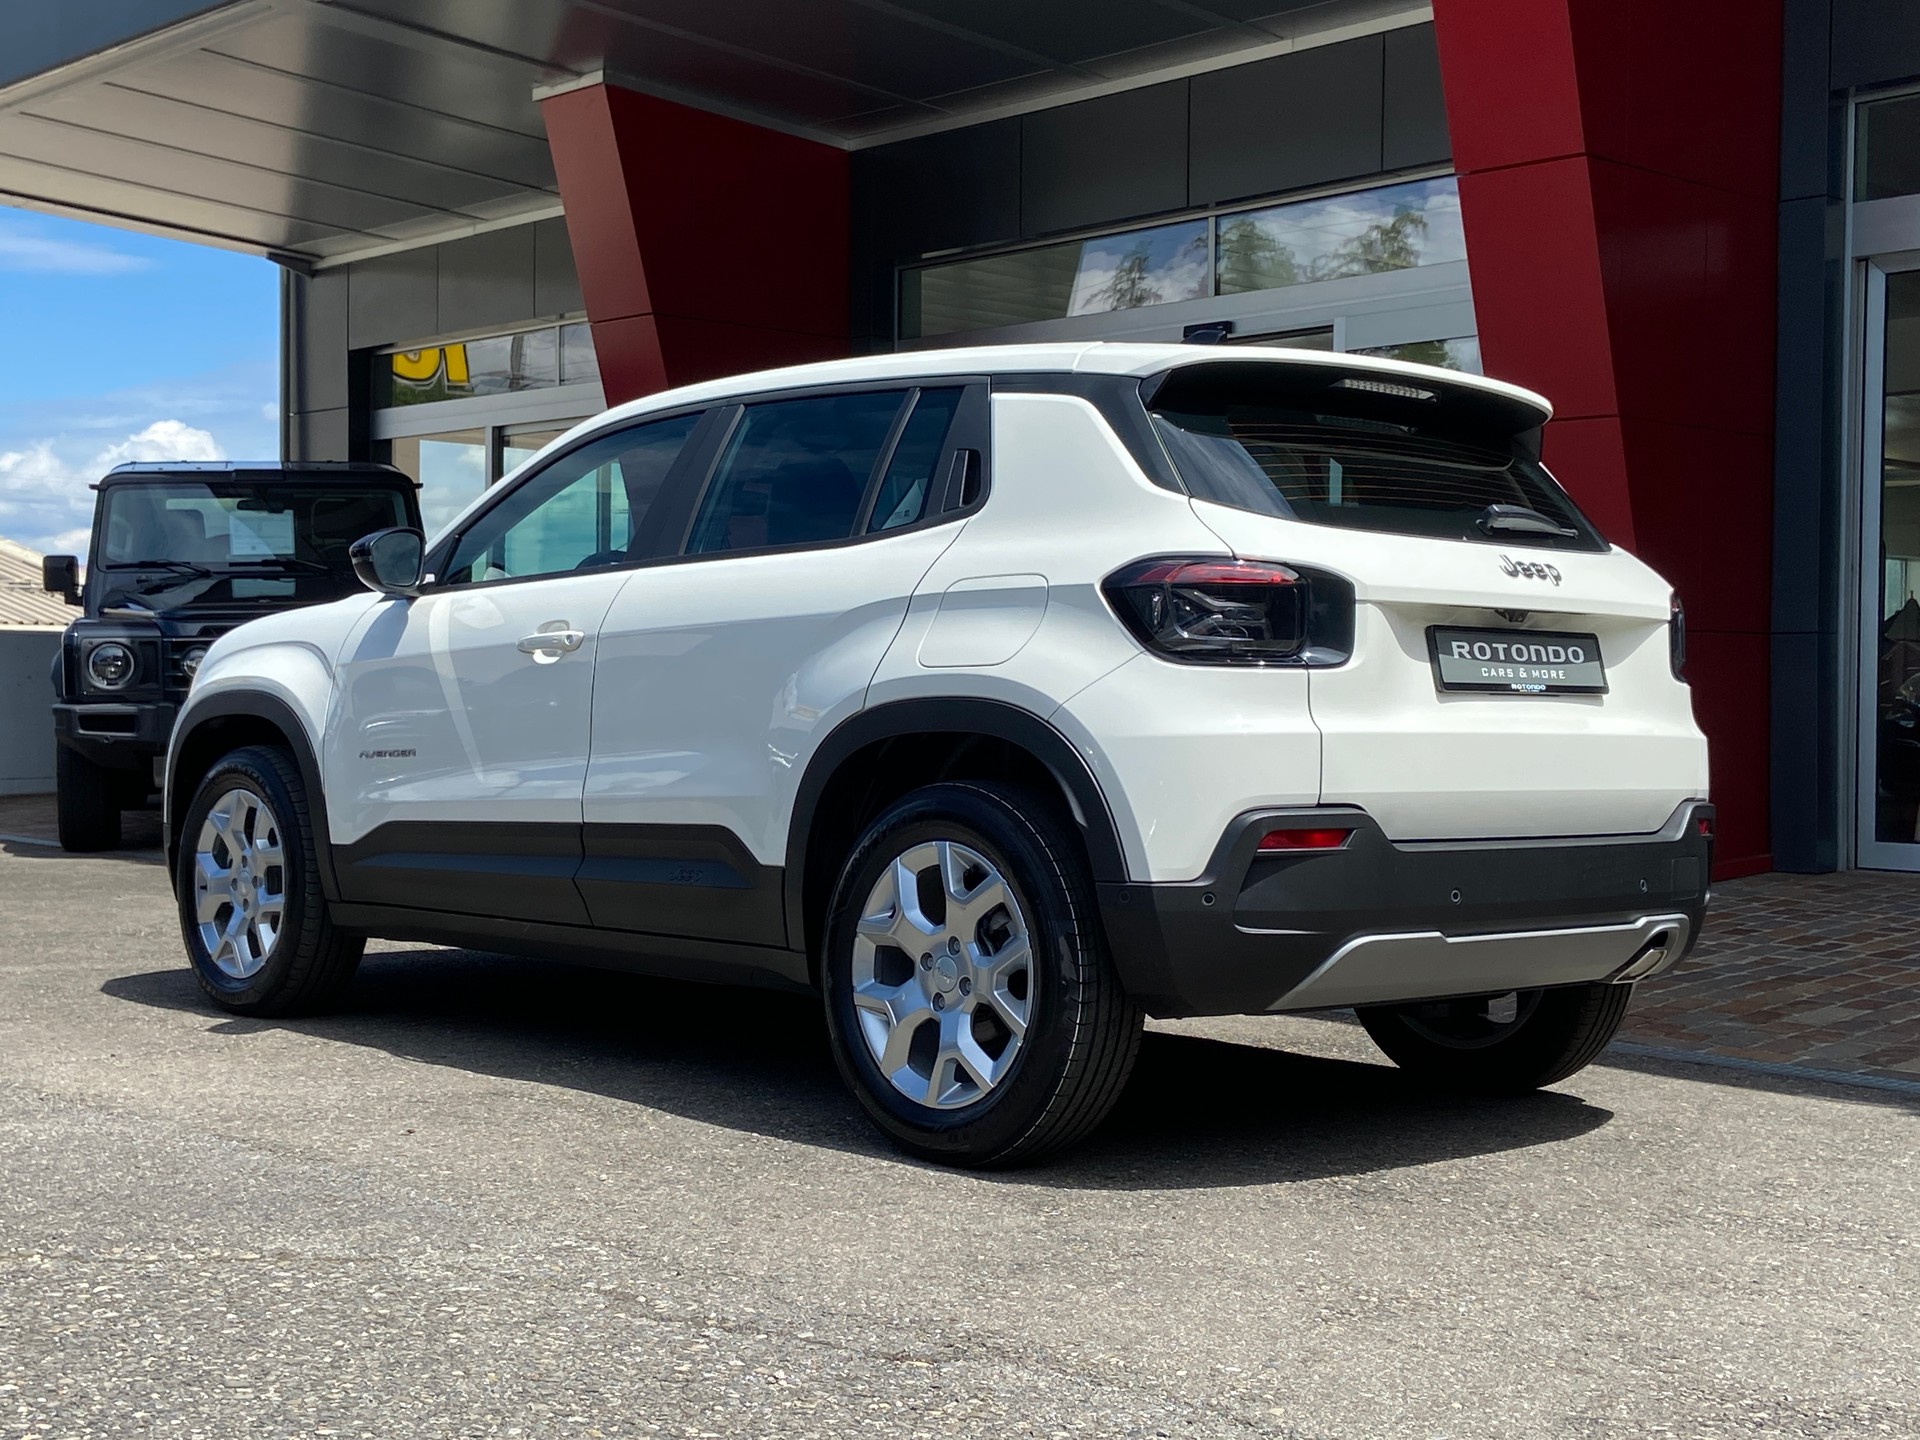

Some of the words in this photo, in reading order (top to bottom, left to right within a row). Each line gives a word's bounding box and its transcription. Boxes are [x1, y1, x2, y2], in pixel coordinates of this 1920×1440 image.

[1498, 554, 1562, 587] Jeep
[1451, 640, 1585, 664] ROTONDO
[1481, 667, 1514, 678] CARS
[1519, 667, 1528, 678] &
[1532, 668, 1566, 680] MORE
